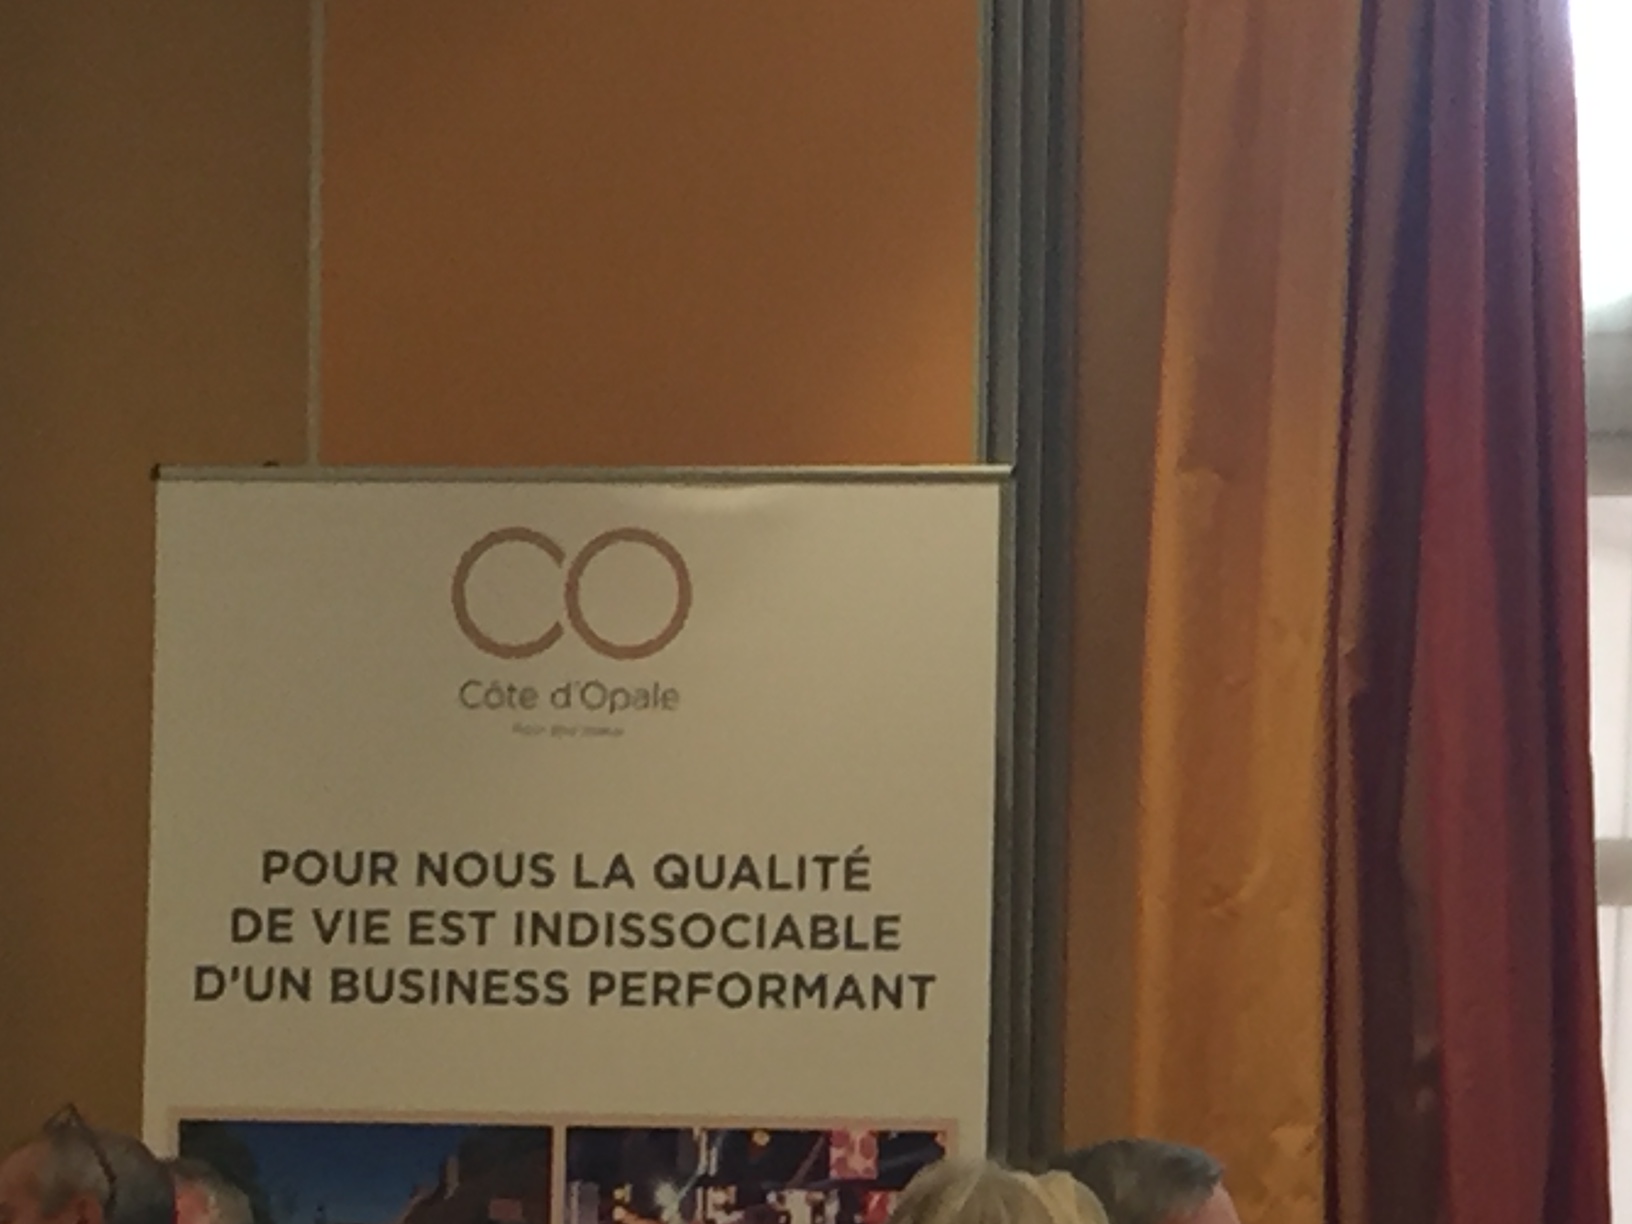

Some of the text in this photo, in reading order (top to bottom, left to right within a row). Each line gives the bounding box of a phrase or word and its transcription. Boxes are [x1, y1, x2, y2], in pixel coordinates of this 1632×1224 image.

[450, 526, 692, 661] CO
[458, 678, 681, 715] Côte d'Opale
[262, 844, 871, 892] POUR NOUS LA QUALITÉ
[231, 907, 901, 952] DE VIE EST INDISSOCIABLE
[194, 965, 937, 1011] D'UN BUSINESS PERFORMANT
